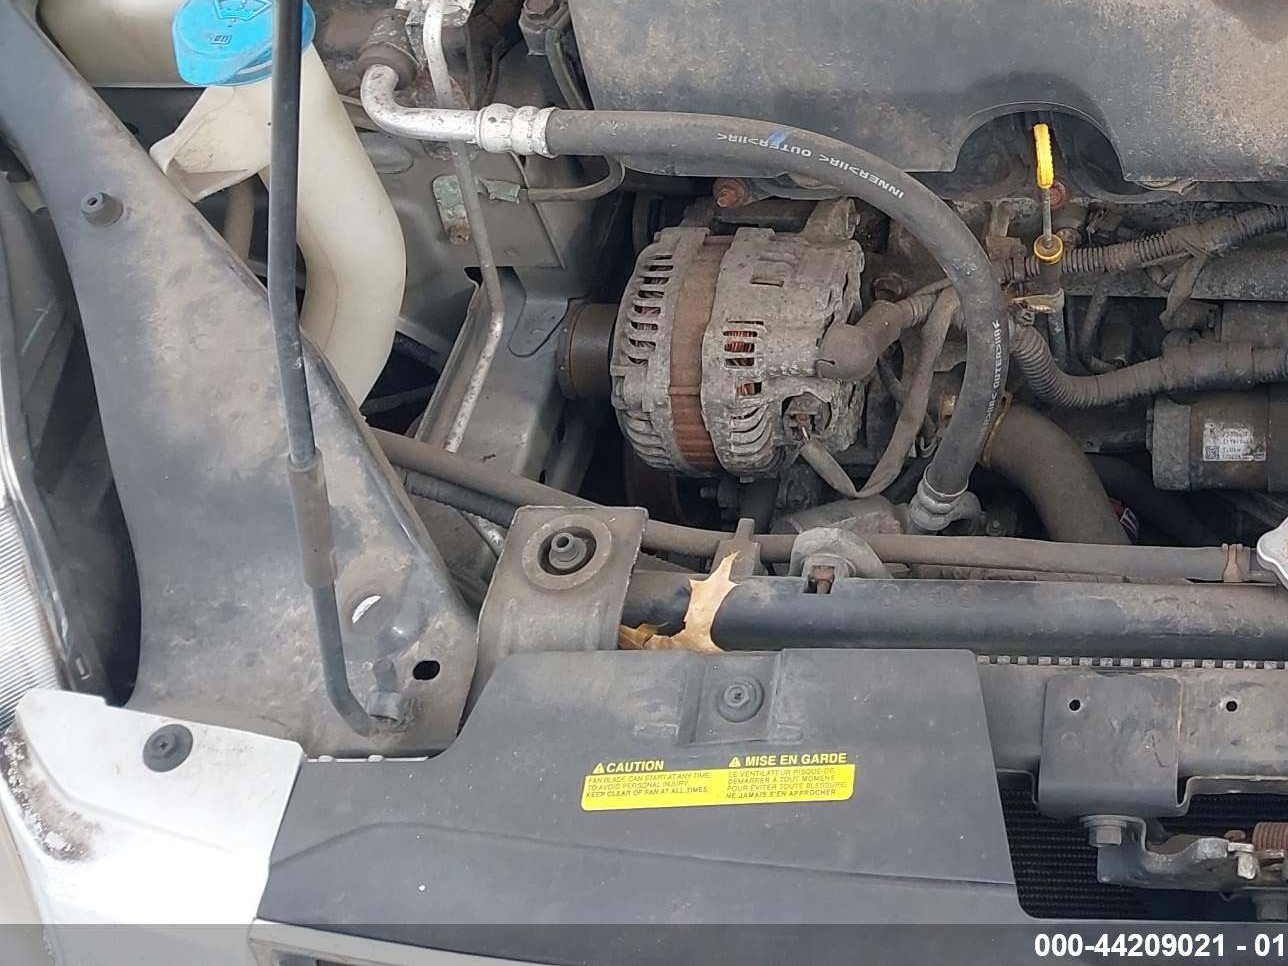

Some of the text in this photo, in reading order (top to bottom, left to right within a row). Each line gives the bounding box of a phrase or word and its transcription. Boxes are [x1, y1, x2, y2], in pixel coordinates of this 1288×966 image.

[745, 752, 848, 767] MISE EN GARDE
[606, 760, 664, 773] CAUTION
[622, 782, 660, 790] PERSONAL
[738, 791, 767, 799] JAMAIS
